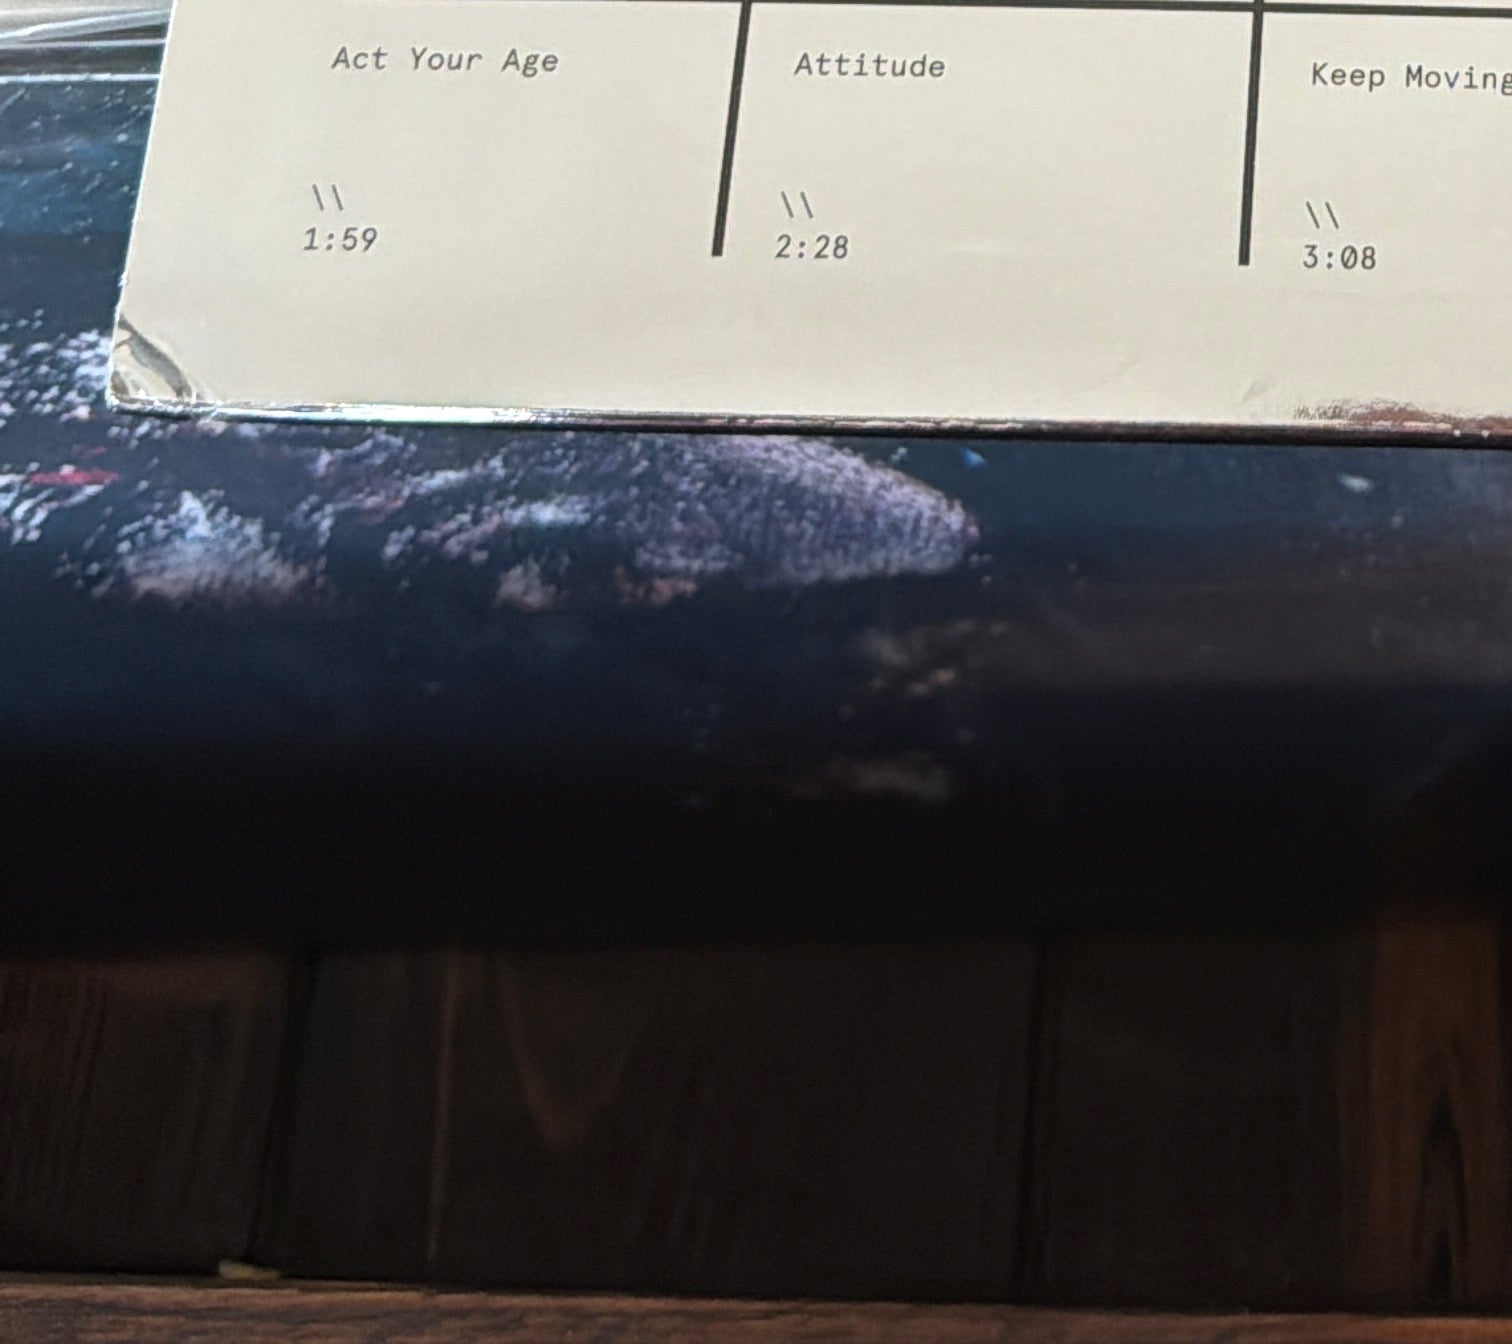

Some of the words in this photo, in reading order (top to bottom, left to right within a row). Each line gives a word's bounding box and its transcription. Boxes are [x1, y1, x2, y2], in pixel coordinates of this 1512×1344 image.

[331, 46, 388, 70] Act
[411, 47, 483, 71] Your
[501, 48, 558, 78] Age
[794, 53, 945, 78] Attitude
[1311, 62, 1385, 92] Keep
[303, 227, 378, 252] 1:59
[775, 234, 849, 259] 2:28
[1303, 244, 1377, 270] 3:08
